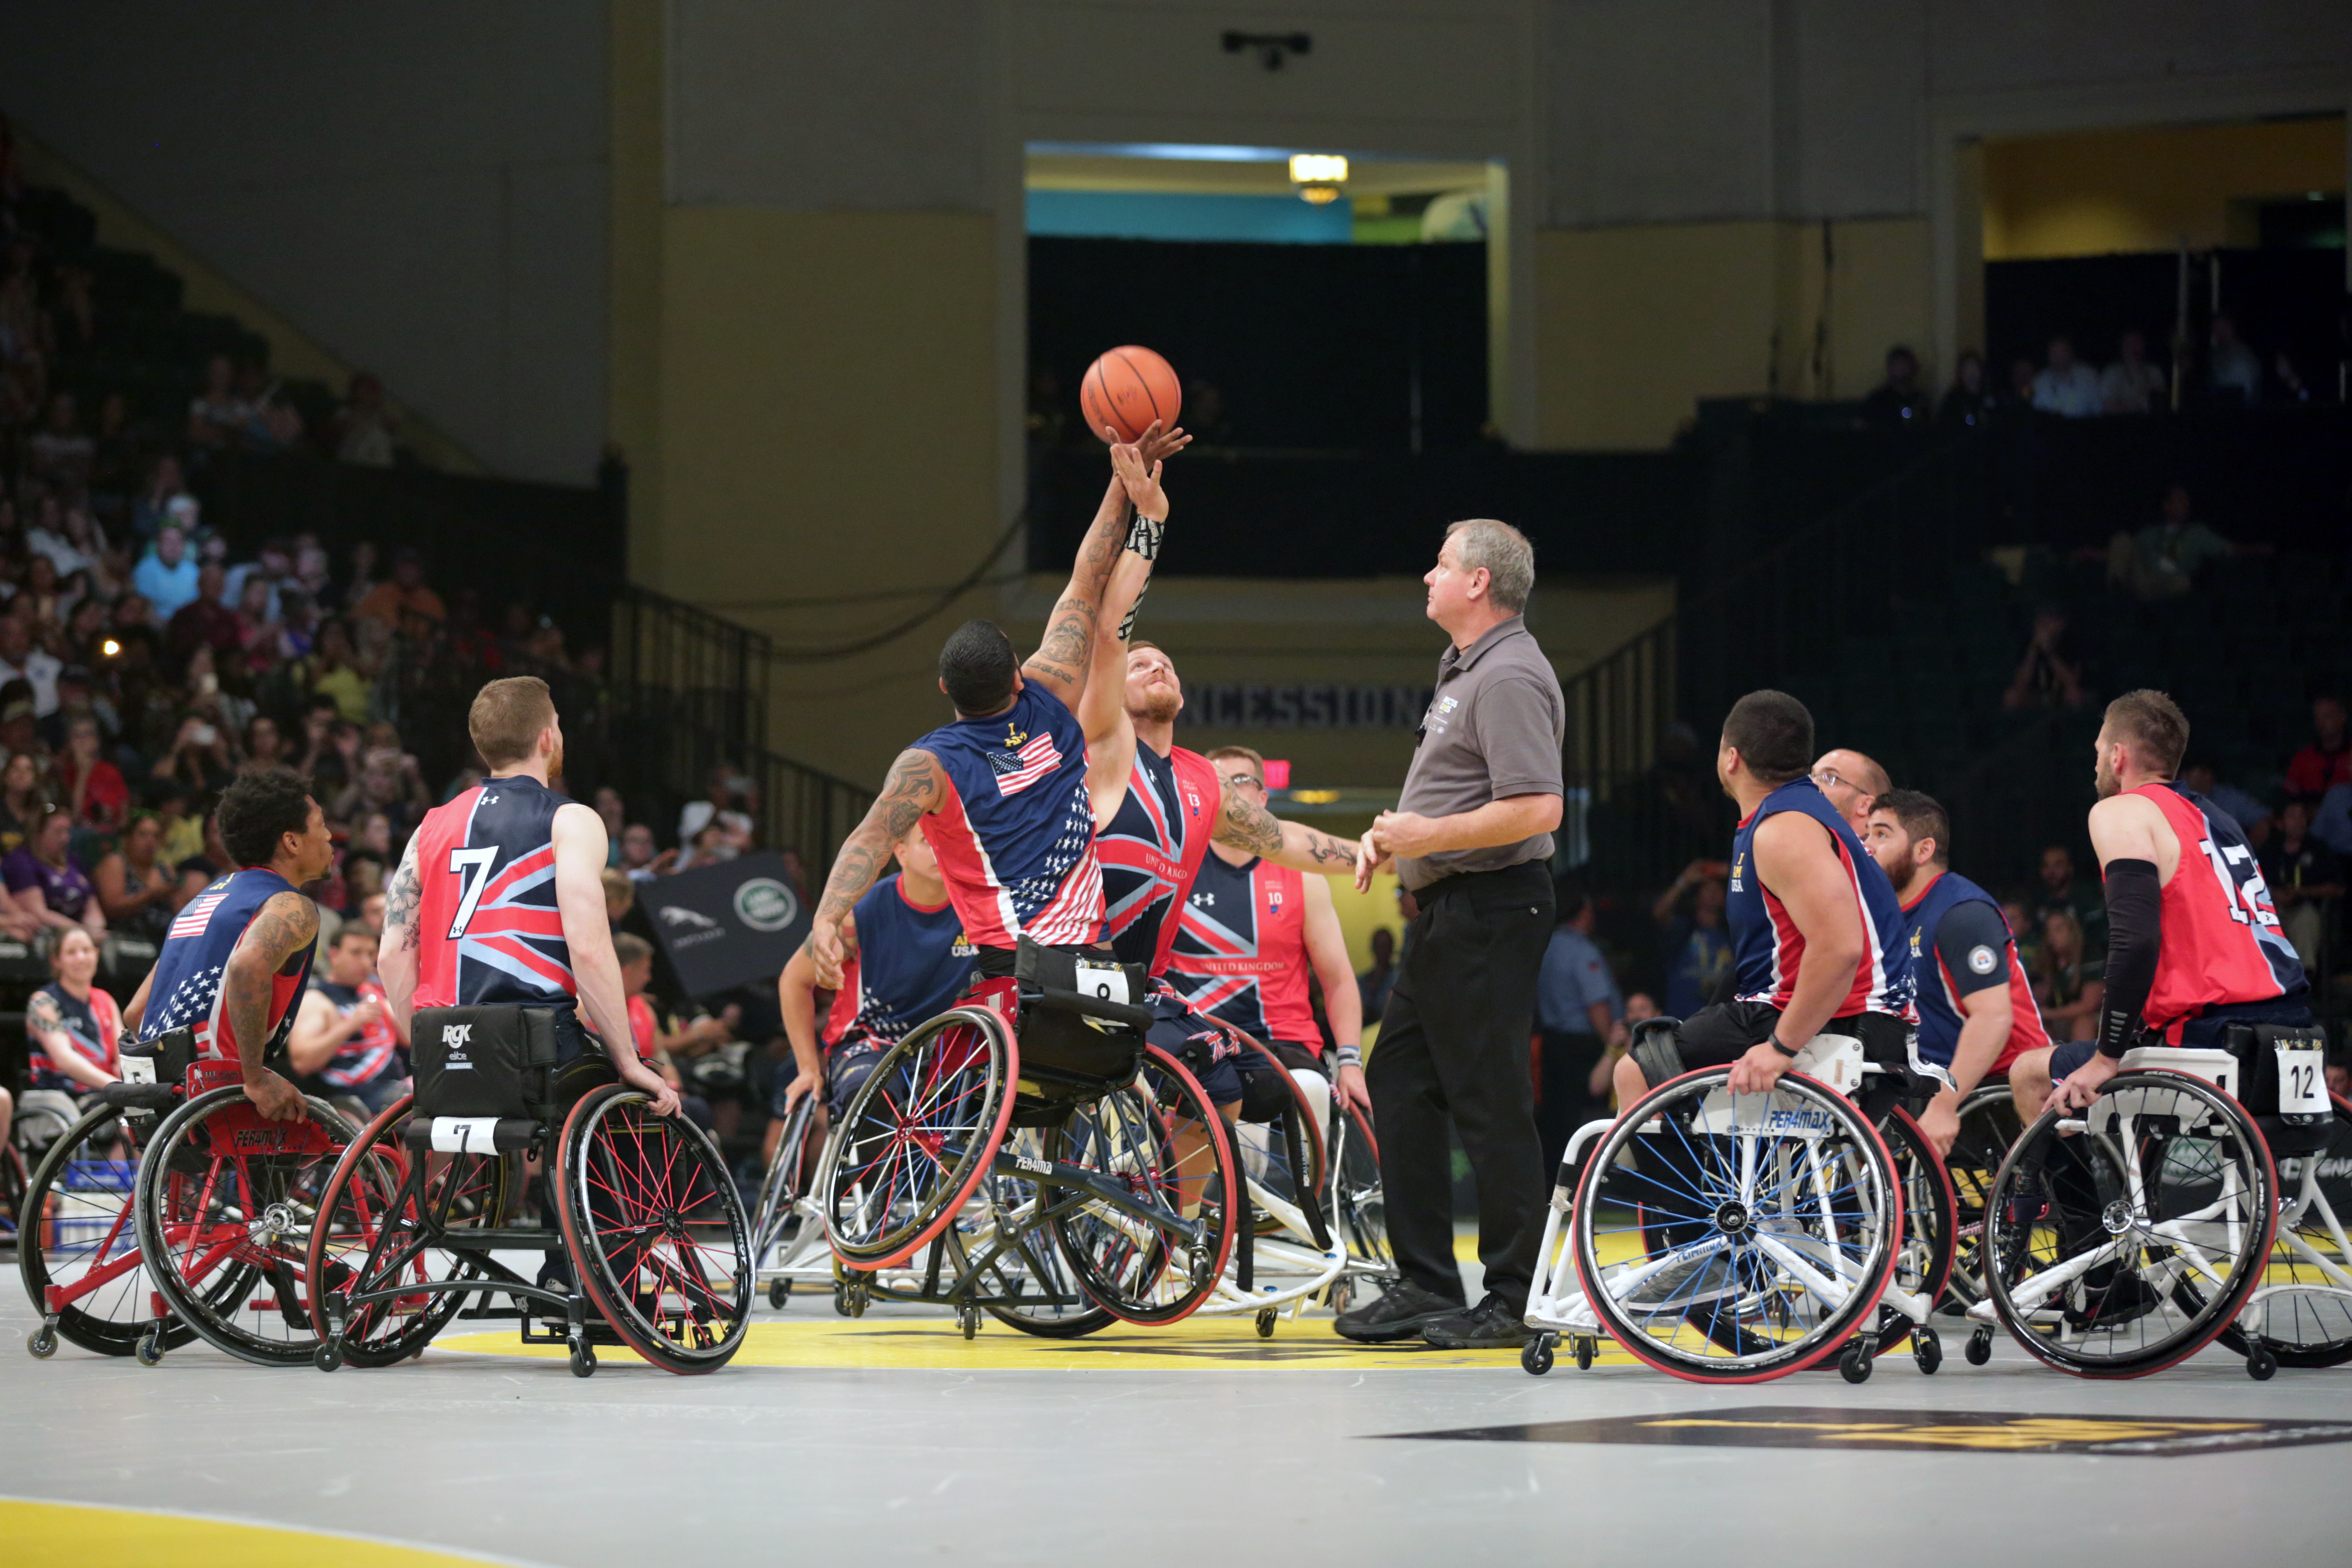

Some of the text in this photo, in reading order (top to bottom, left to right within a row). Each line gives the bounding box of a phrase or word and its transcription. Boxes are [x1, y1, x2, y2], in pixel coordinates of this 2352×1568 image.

[1008, 723, 1015, 736] I
[1187, 793, 1200, 807] 13
[2199, 838, 2280, 926] 12
[446, 845, 499, 941] 7
[1268, 892, 1283, 905] 10
[951, 945, 980, 957] USA
[449, 1051, 467, 1060] elite
[2291, 1065, 2314, 1098] 12
[236, 1130, 288, 1147] PER4MX
[453, 1125, 472, 1153] 7
